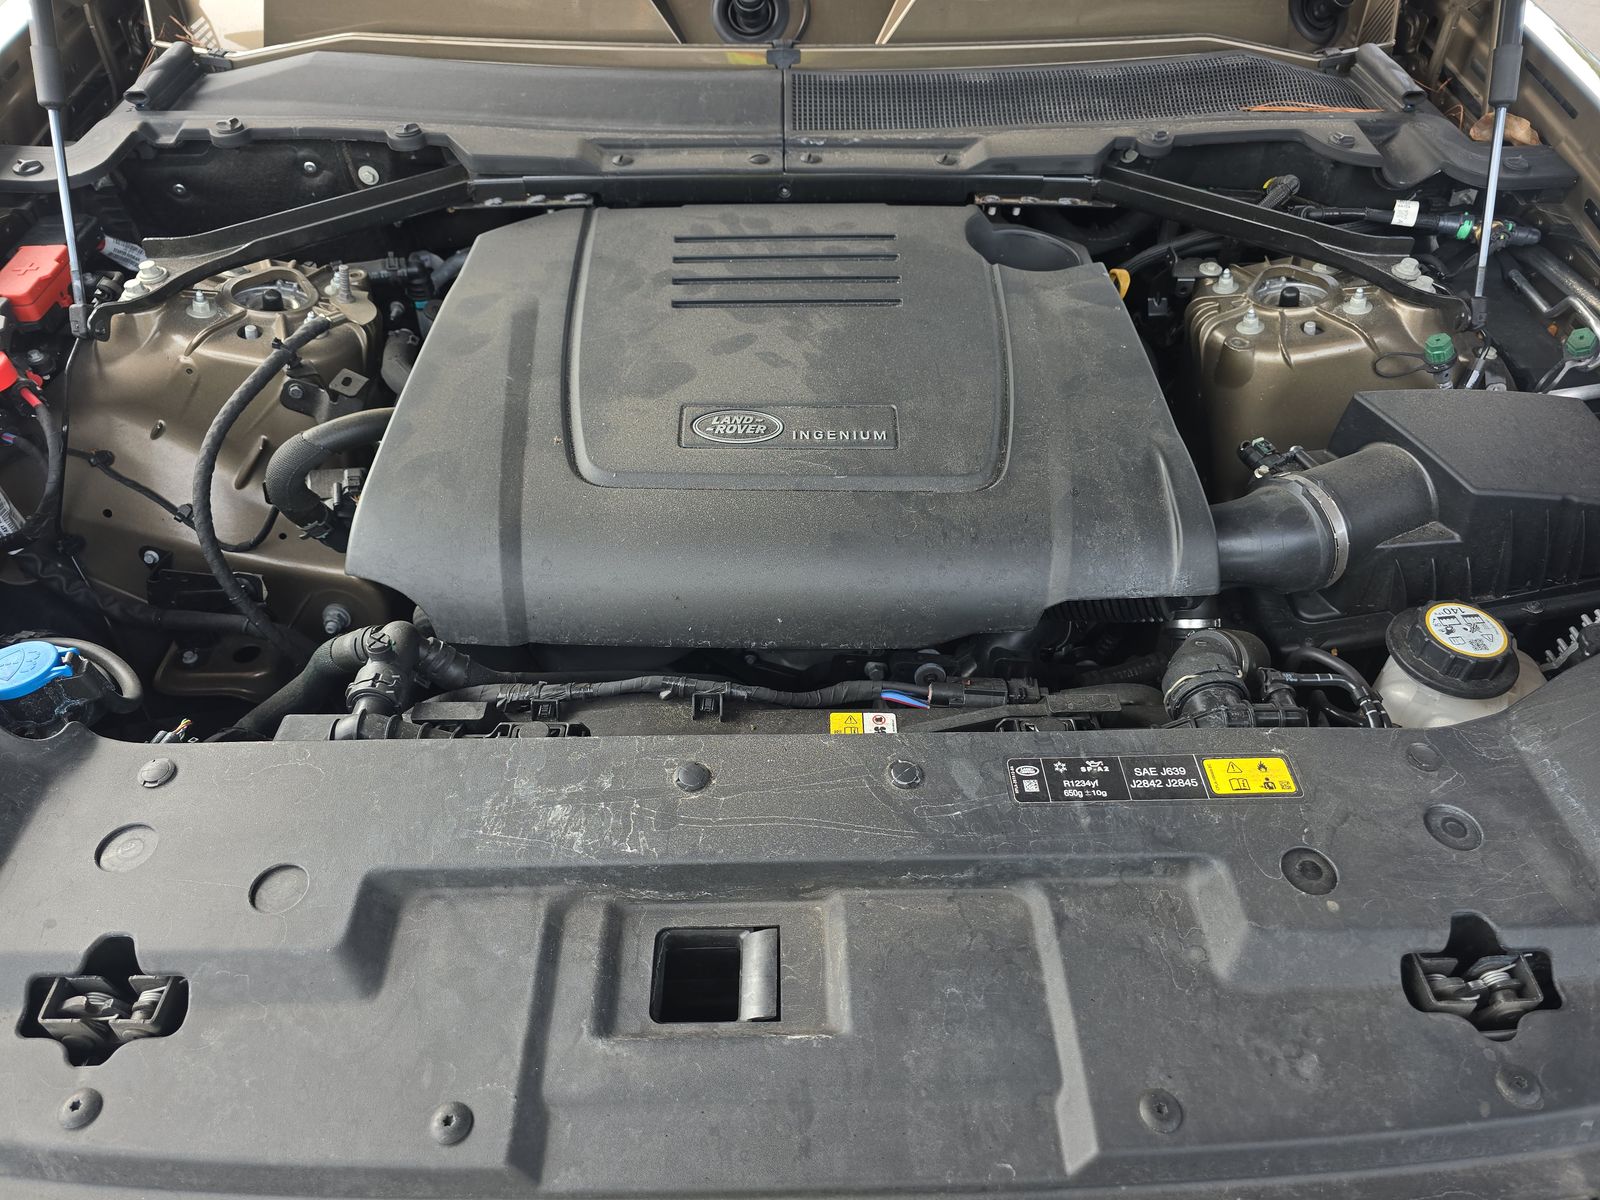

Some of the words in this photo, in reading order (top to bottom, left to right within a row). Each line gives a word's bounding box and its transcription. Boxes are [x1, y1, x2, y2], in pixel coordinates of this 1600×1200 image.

[711, 416, 754, 425] LAND
[714, 424, 767, 434] ROVER
[792, 430, 887, 440] INGENIUM
[1134, 768, 1159, 776] SAE
[1160, 766, 1187, 776] J639
[1130, 780, 1163, 788] J2842
[1165, 778, 1199, 788] J2845
[1063, 790, 1084, 798] 650g
